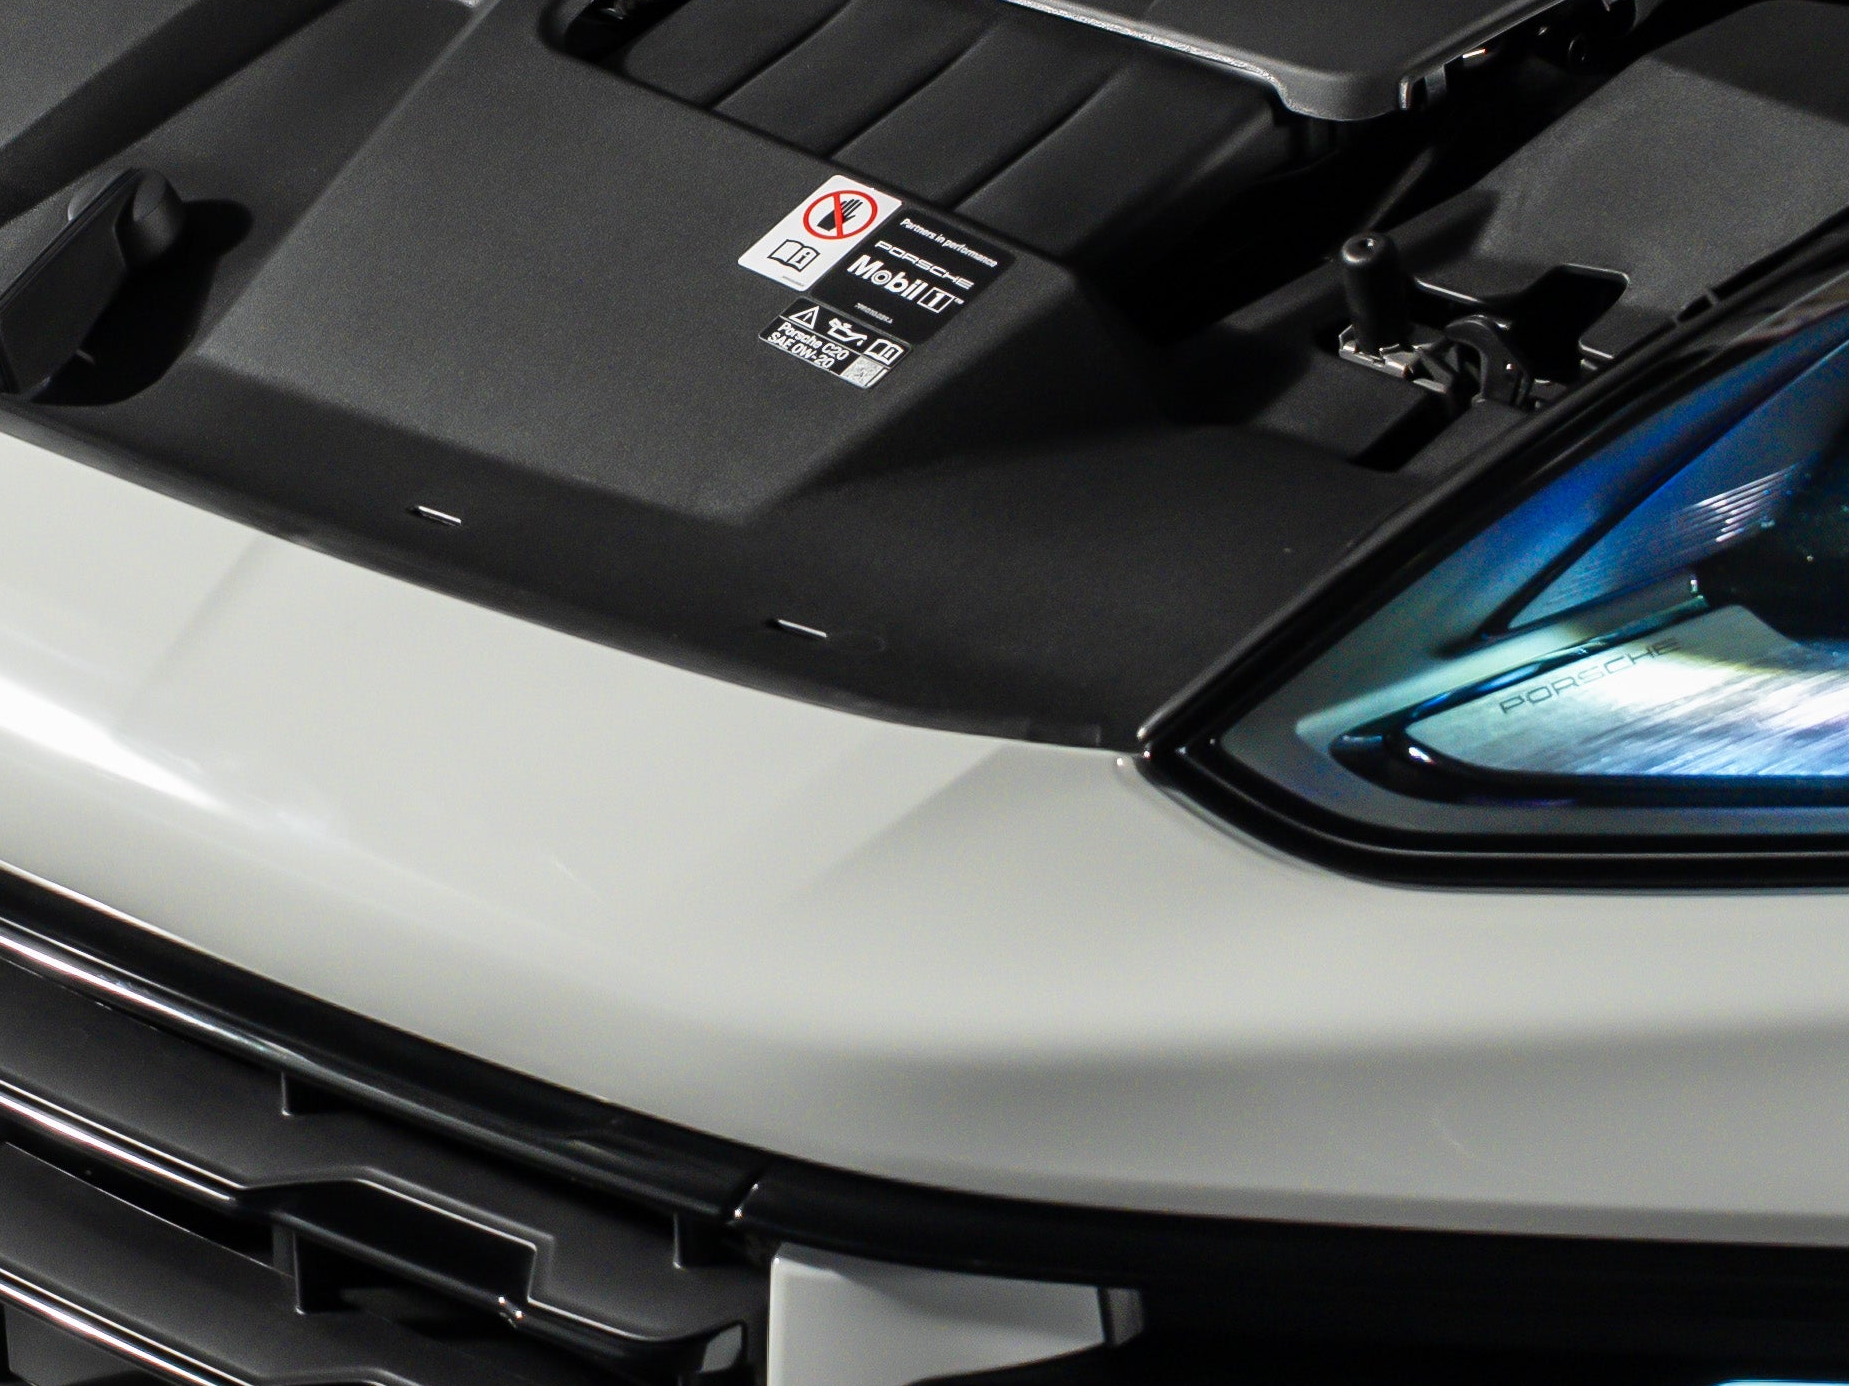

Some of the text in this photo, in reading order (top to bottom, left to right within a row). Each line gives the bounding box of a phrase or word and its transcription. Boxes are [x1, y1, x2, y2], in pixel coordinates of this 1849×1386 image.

[874, 240, 975, 290] PORSCHE
[900, 218, 998, 268] Partners in performance
[847, 254, 928, 300] Mobil
[767, 331, 835, 369] SAE 0W-20
[777, 321, 850, 361] Porsche C20
[1498, 637, 1681, 714] PORSCHE
